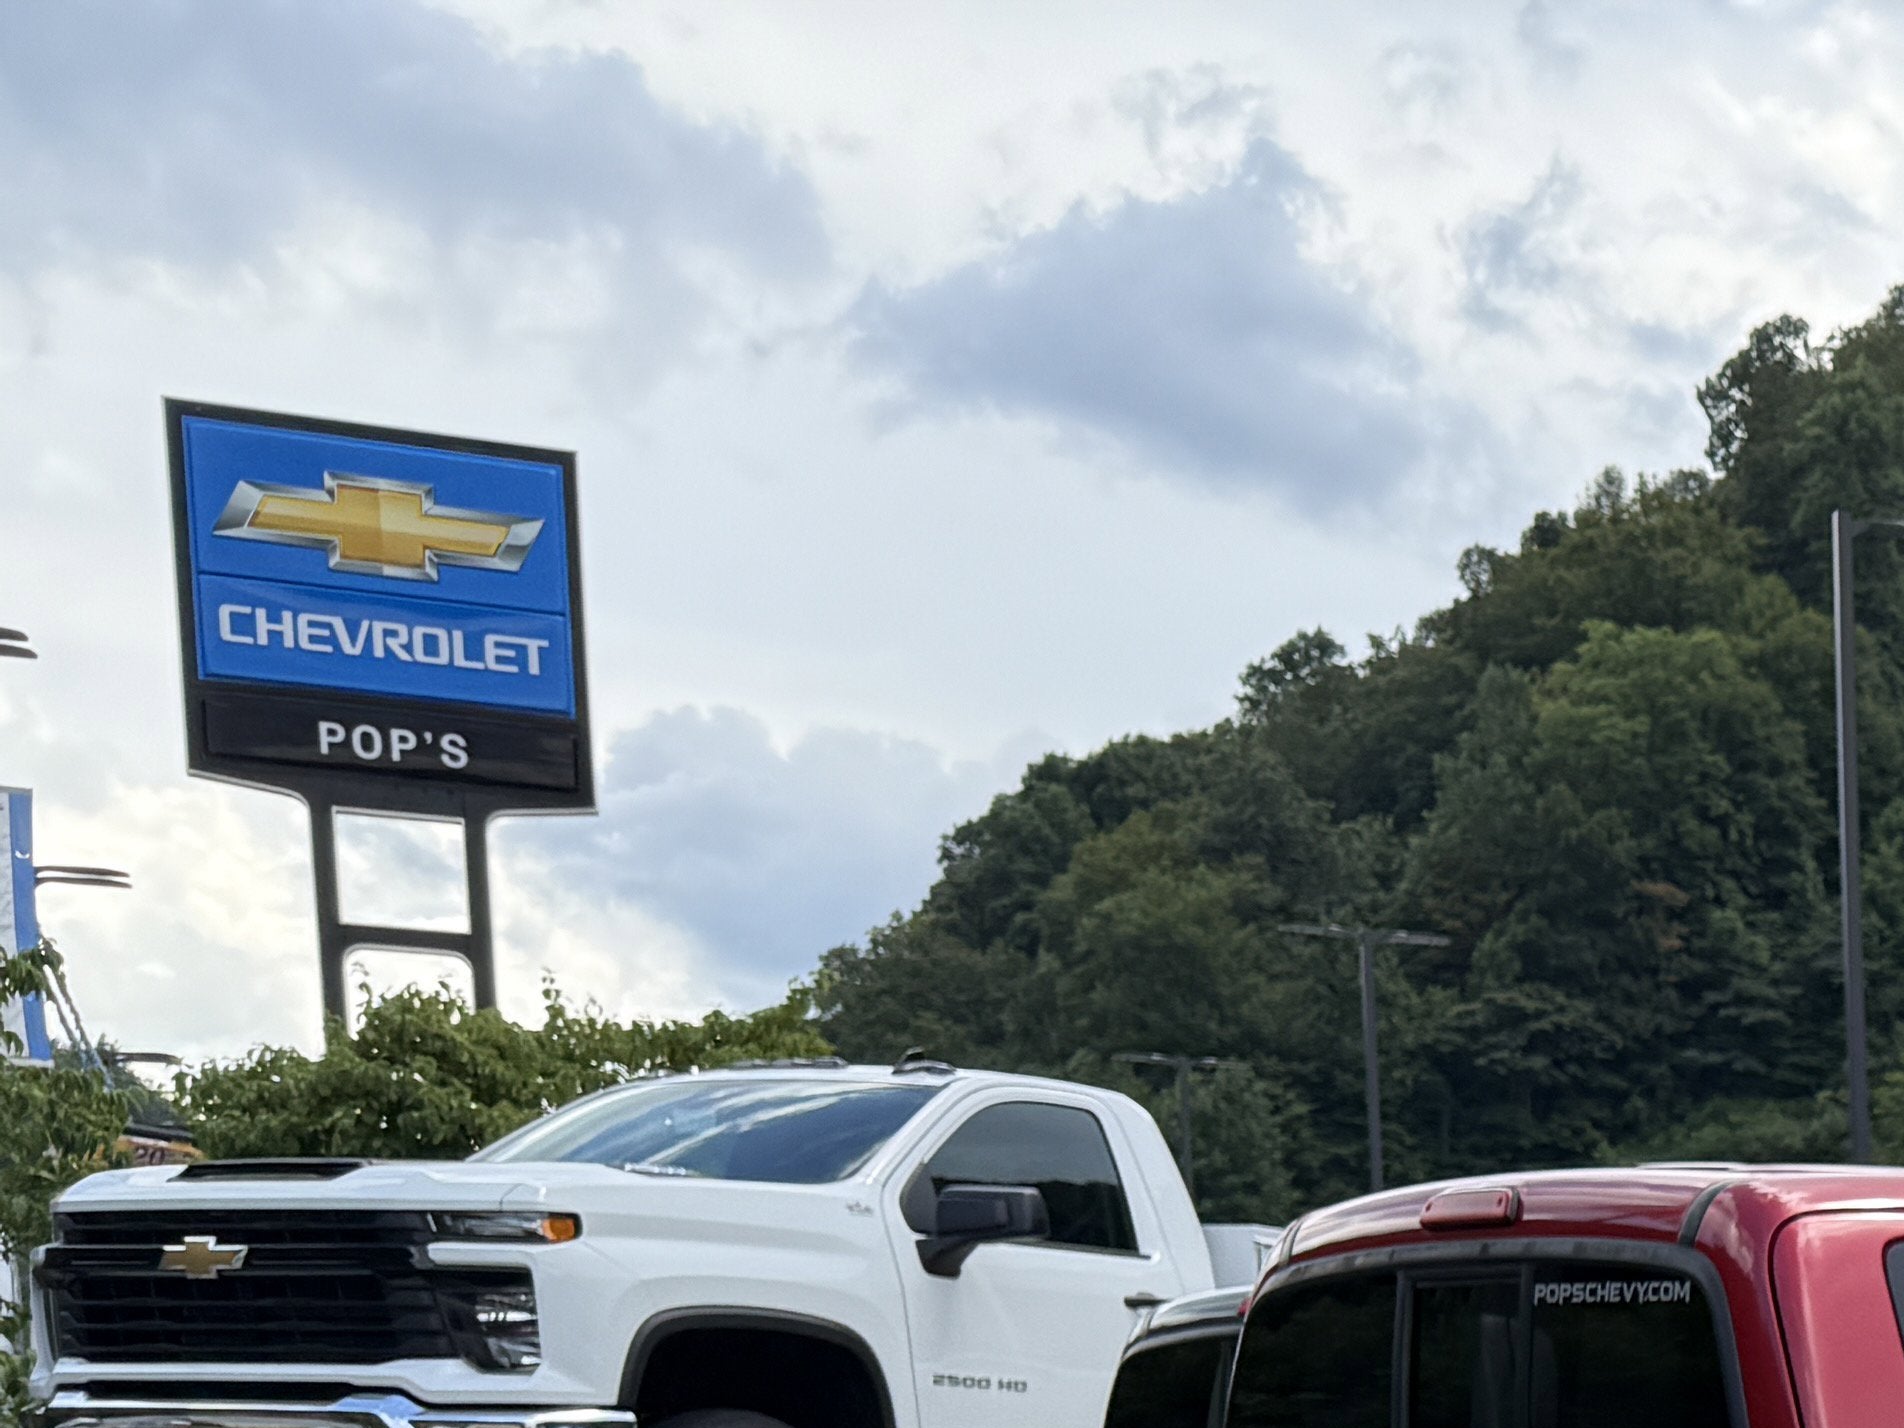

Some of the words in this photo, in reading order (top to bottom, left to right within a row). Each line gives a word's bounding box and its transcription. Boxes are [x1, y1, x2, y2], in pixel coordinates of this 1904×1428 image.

[218, 604, 549, 676] CHEVROLET
[318, 721, 469, 769] POP'S
[1533, 1281, 1690, 1306] POPSCHEVY.COM
[932, 1374, 991, 1390] 2500
[997, 1379, 1028, 1393] HD
